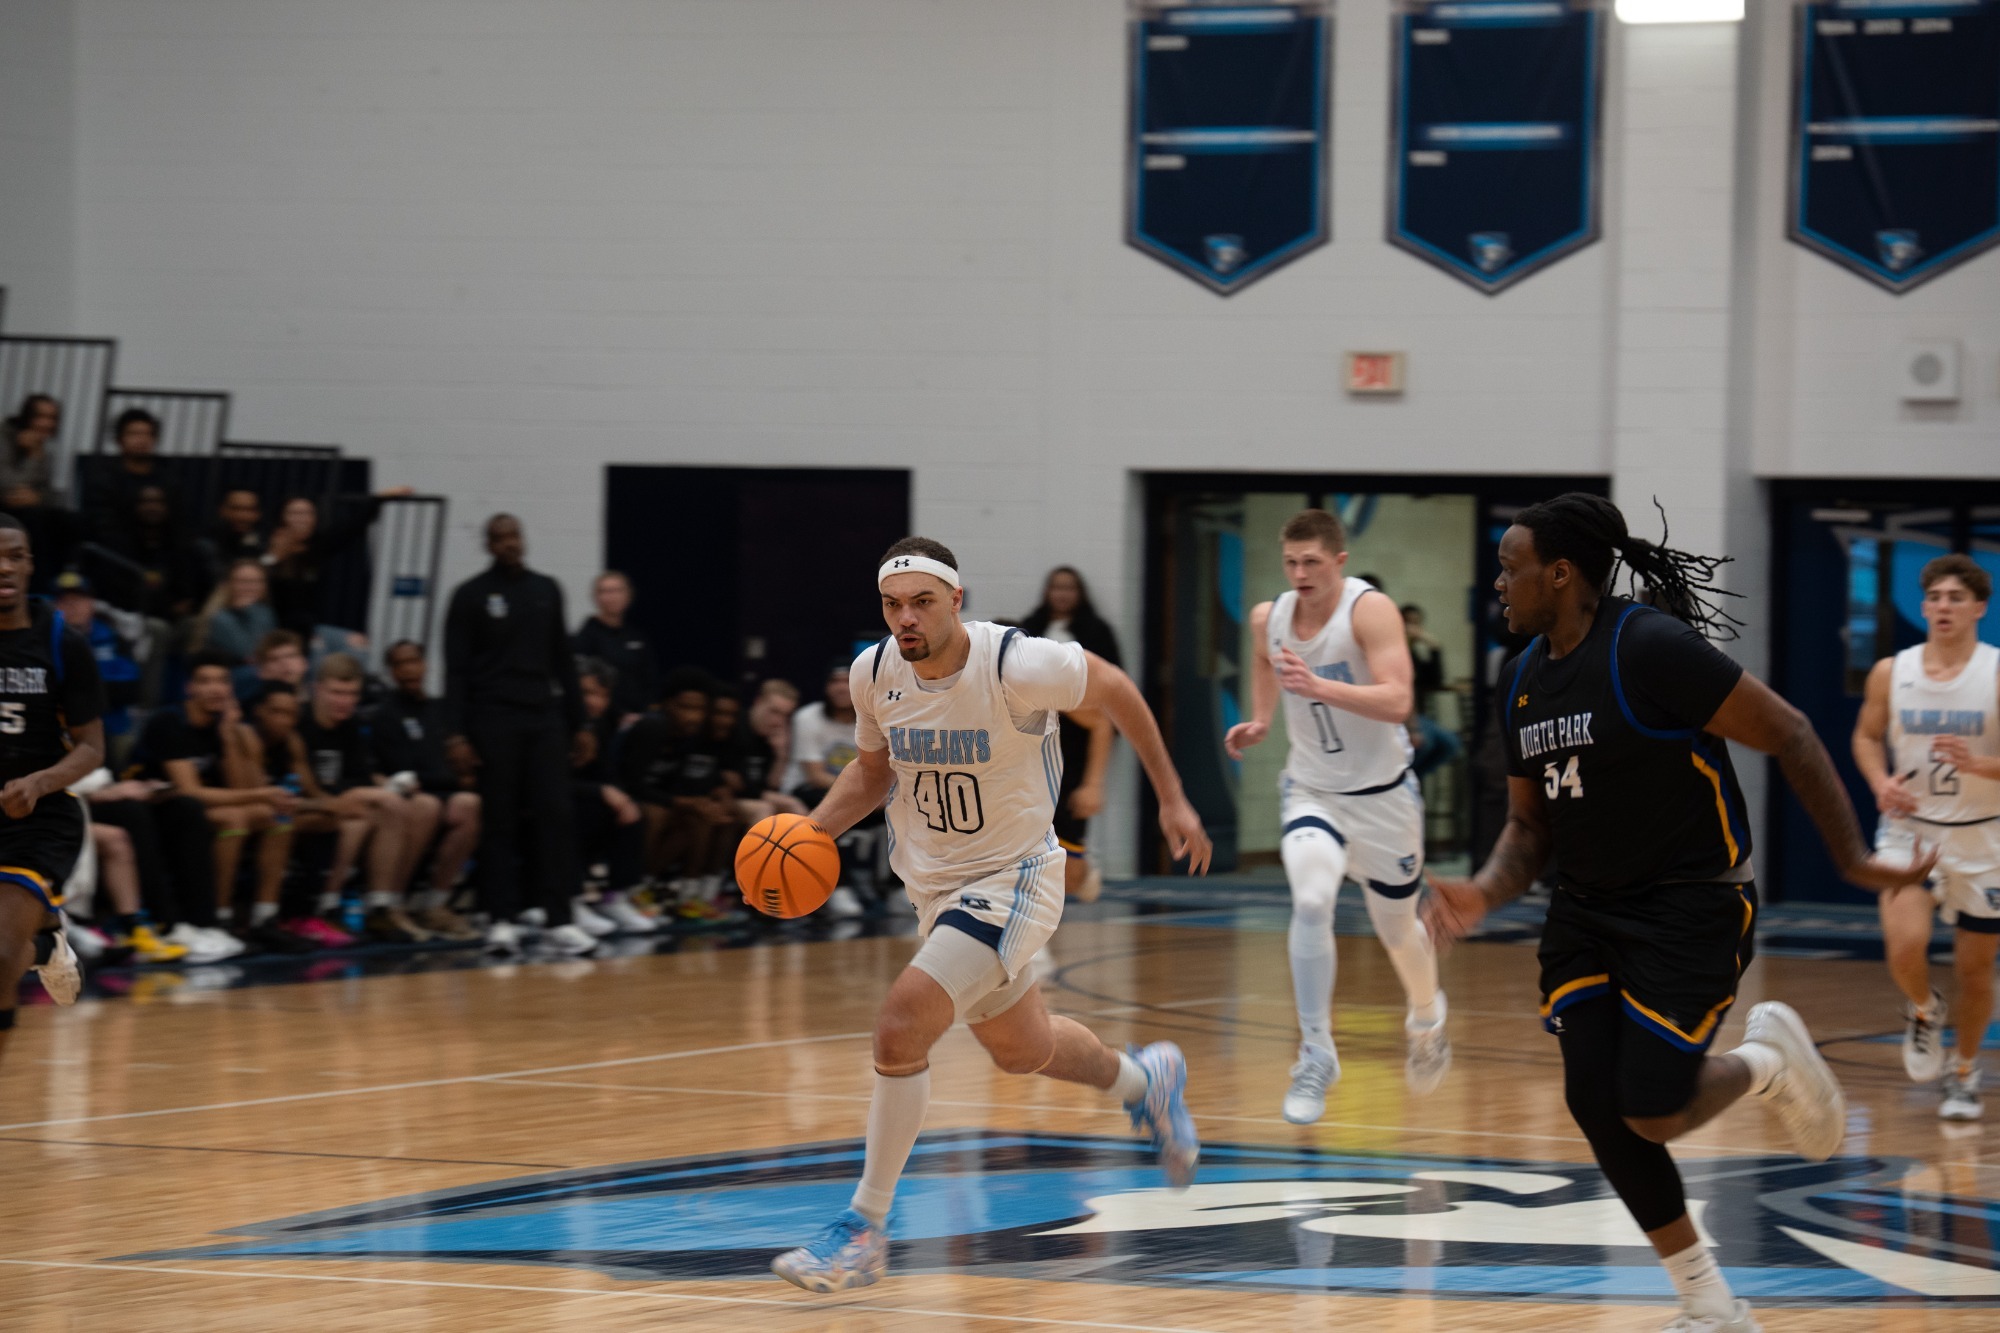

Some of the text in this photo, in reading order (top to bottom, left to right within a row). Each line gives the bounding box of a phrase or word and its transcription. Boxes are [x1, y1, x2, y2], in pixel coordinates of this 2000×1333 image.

[1519, 712, 1594, 760] NORTH PARK
[913, 770, 984, 834] 40
